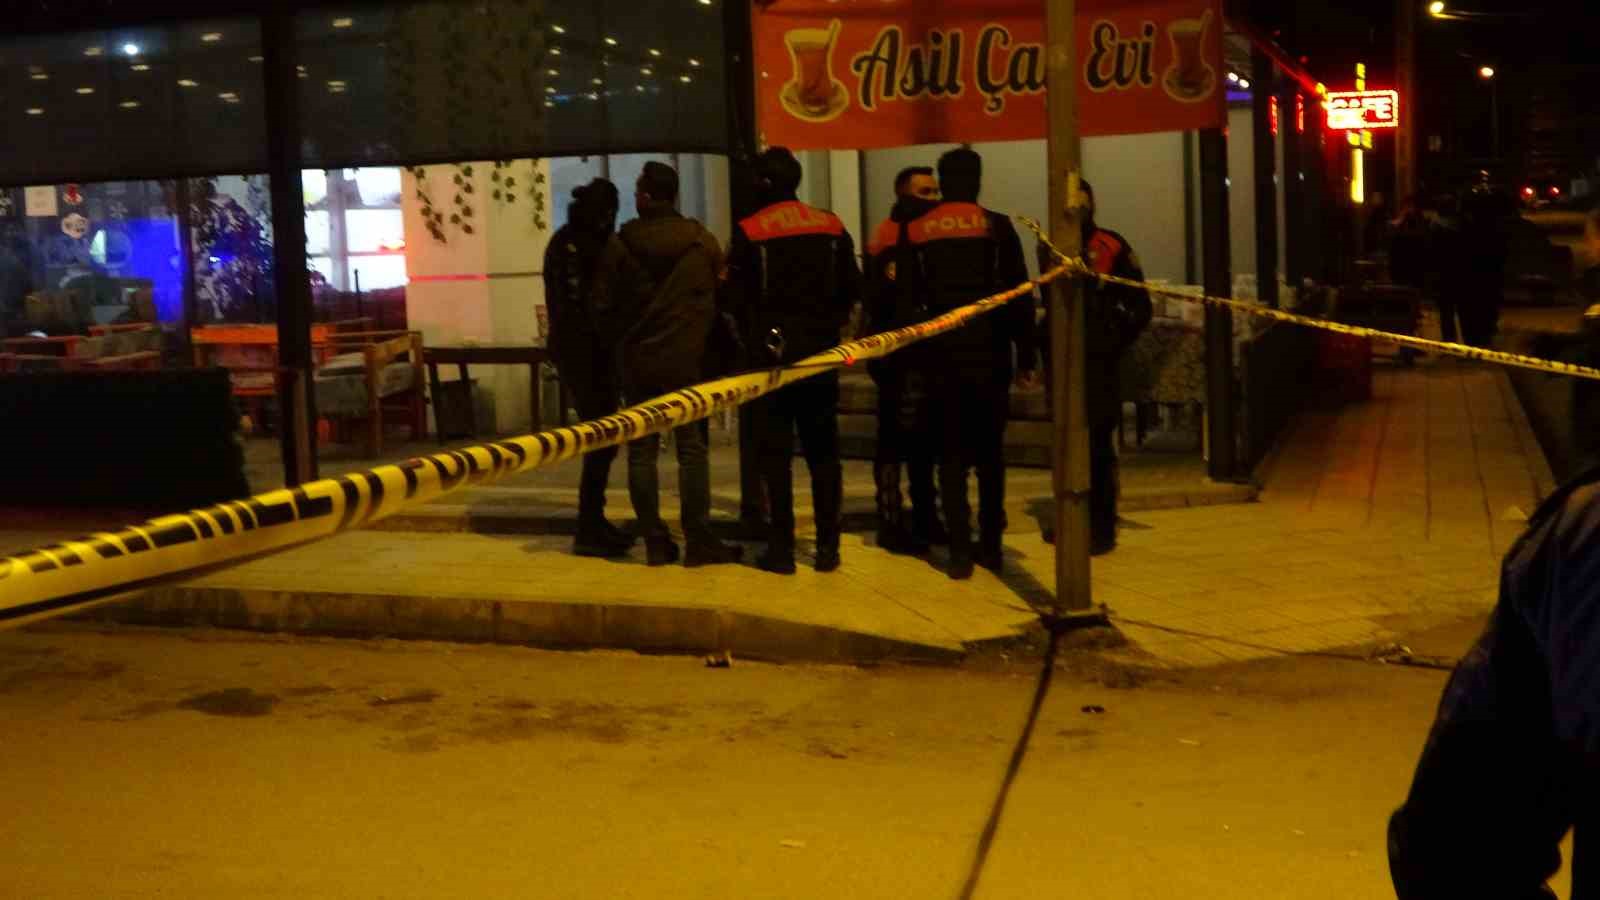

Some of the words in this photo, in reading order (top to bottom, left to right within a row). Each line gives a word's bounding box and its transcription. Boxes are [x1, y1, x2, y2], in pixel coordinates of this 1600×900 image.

[853, 25, 964, 109] Asil
[975, 23, 1048, 115] Ça
[1087, 19, 1154, 92] Evi
